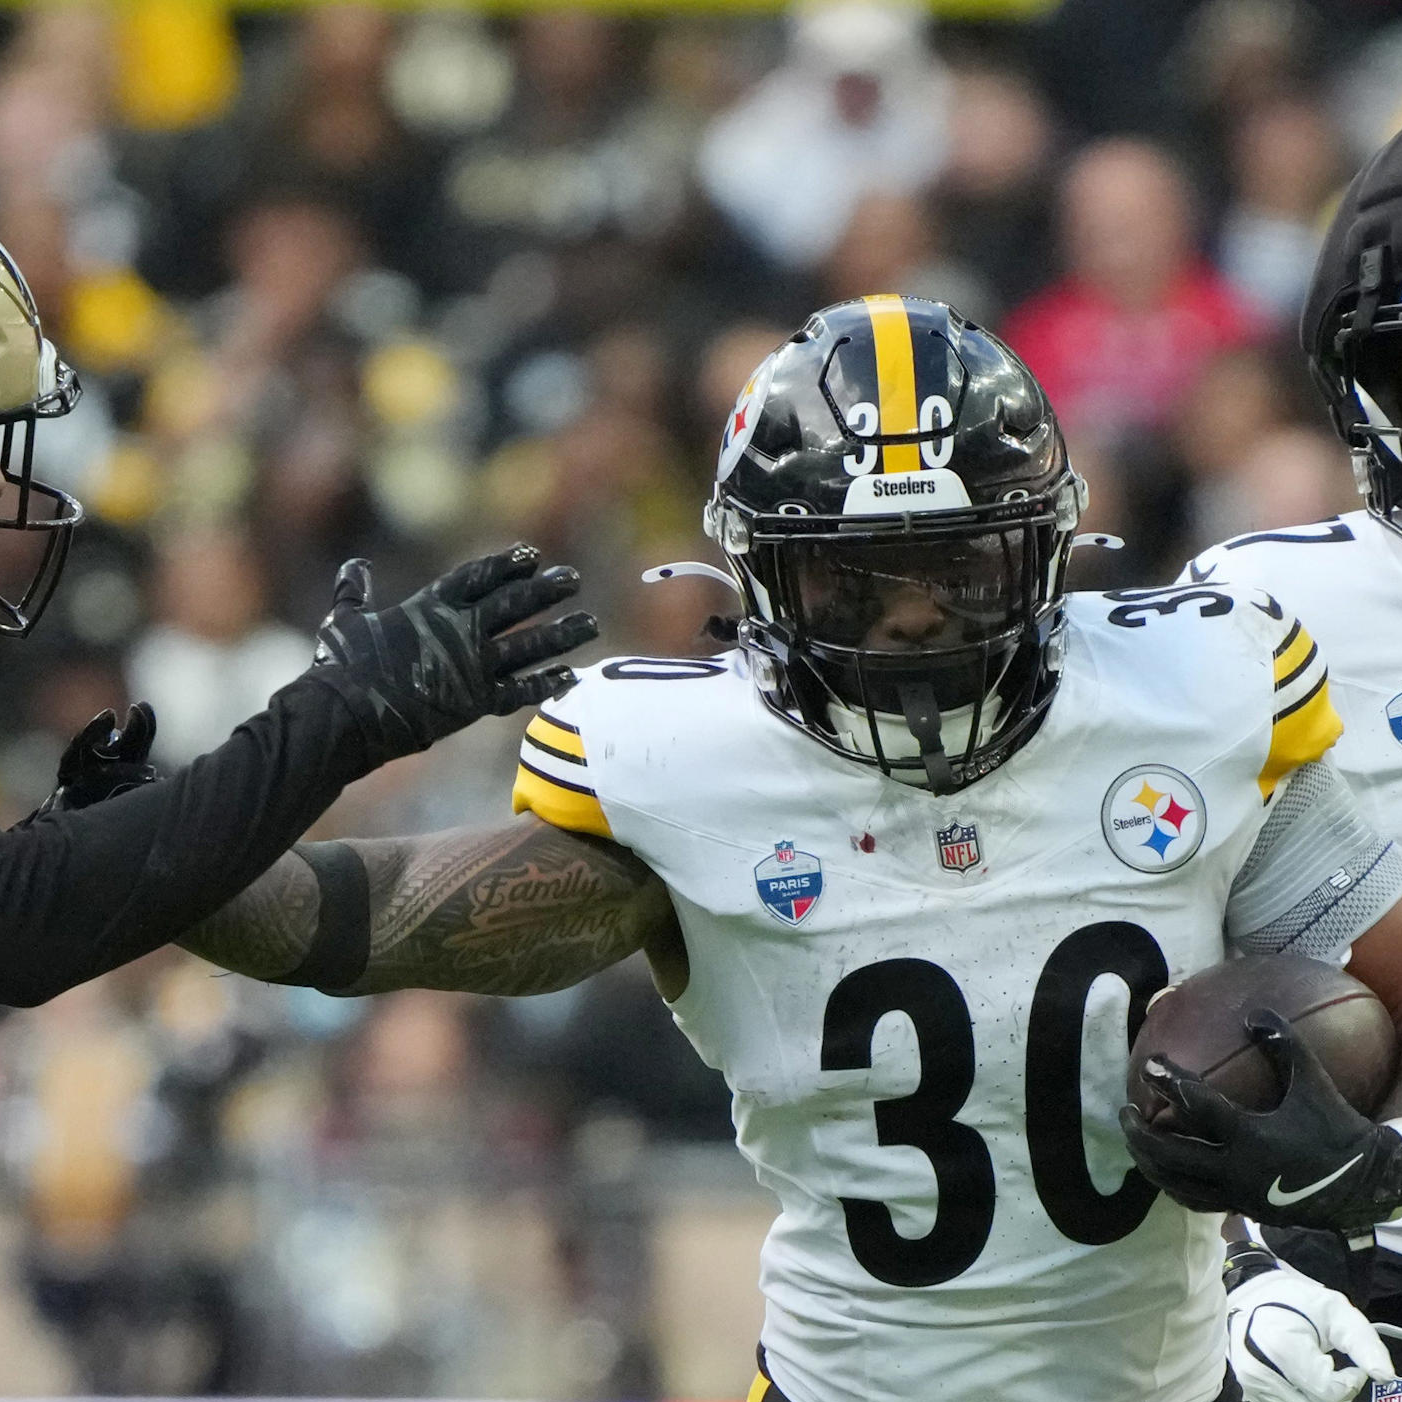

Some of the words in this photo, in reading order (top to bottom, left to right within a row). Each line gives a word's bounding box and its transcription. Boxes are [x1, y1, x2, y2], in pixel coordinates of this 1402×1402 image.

[842, 394, 955, 478] 30
[872, 476, 936, 498] Steelers
[1113, 814, 1152, 831] Steelers
[943, 842, 977, 867] NFL
[769, 876, 811, 892] PARIS
[820, 920, 1169, 1289] 30
